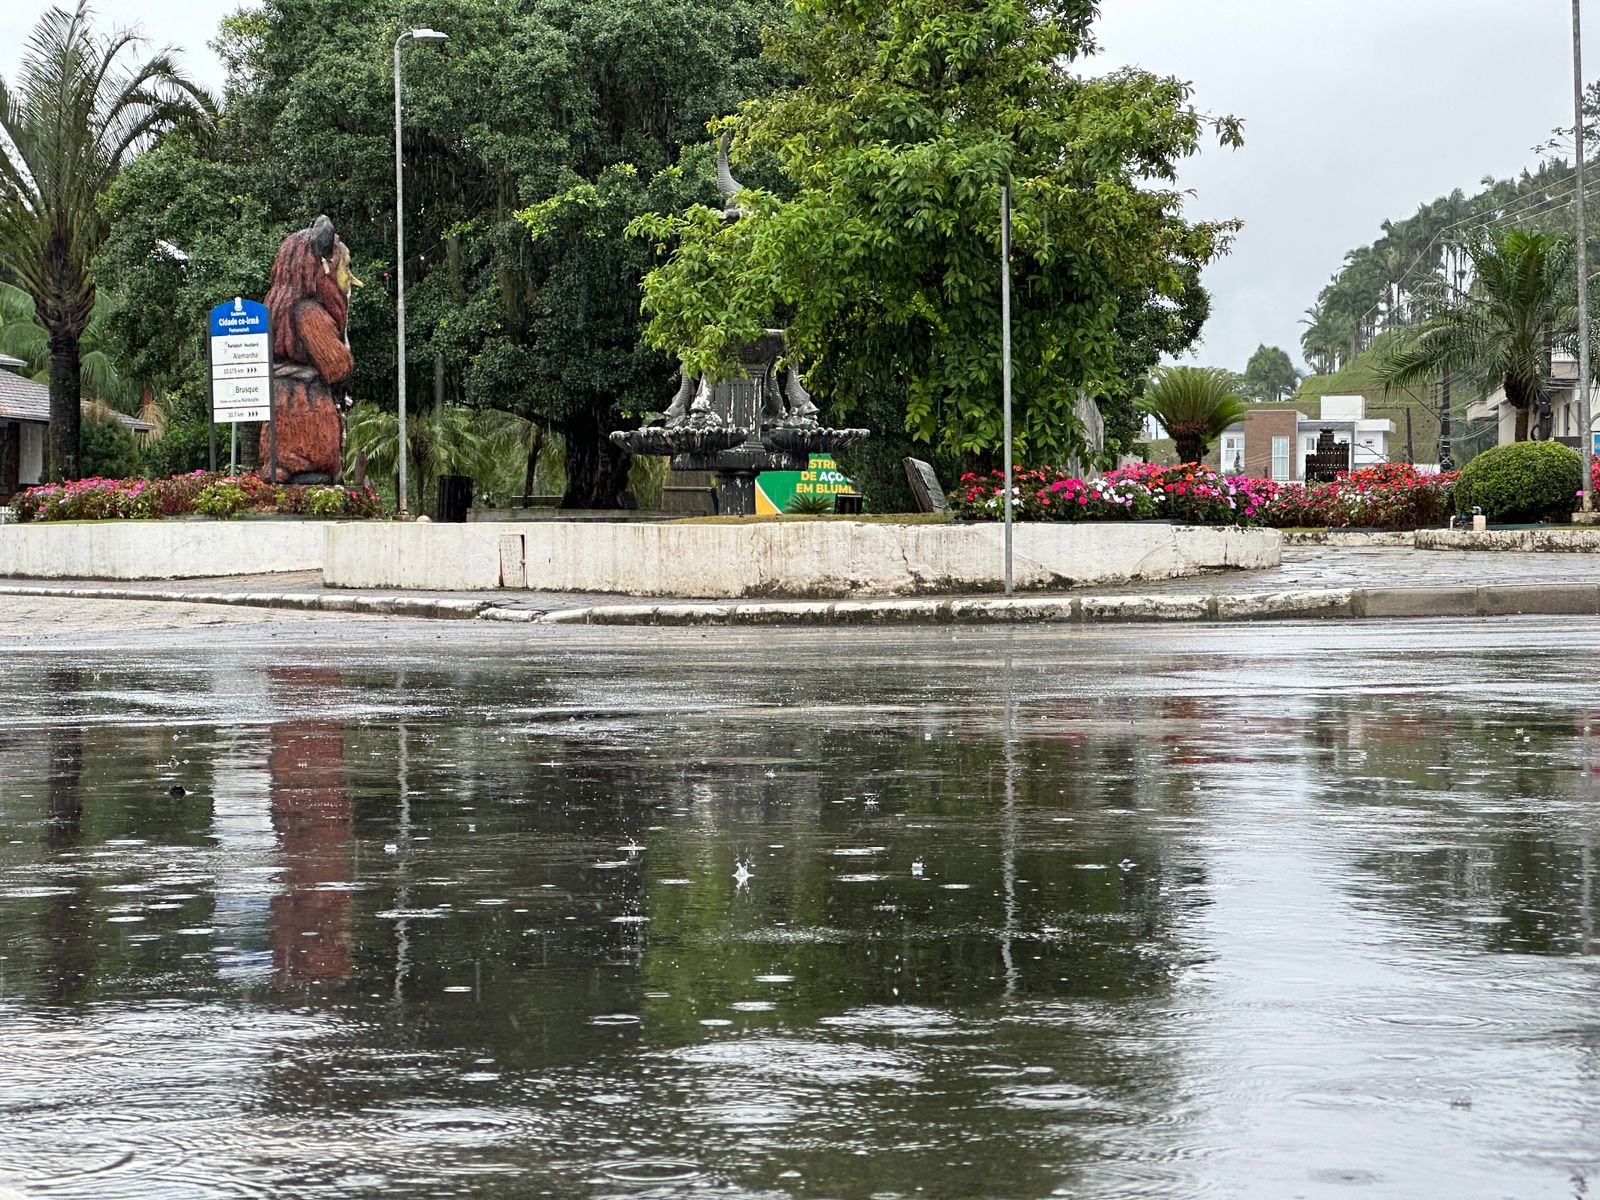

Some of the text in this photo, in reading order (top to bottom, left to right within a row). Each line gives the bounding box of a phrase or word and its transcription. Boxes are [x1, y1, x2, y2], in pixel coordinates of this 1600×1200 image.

[218, 317, 238, 326] Cidade
[235, 385, 259, 394] Brusque
[809, 459, 836, 469] STRI
[801, 471, 817, 481] DE
[819, 471, 844, 484] AÇO
[796, 483, 857, 494] EM BLUME
